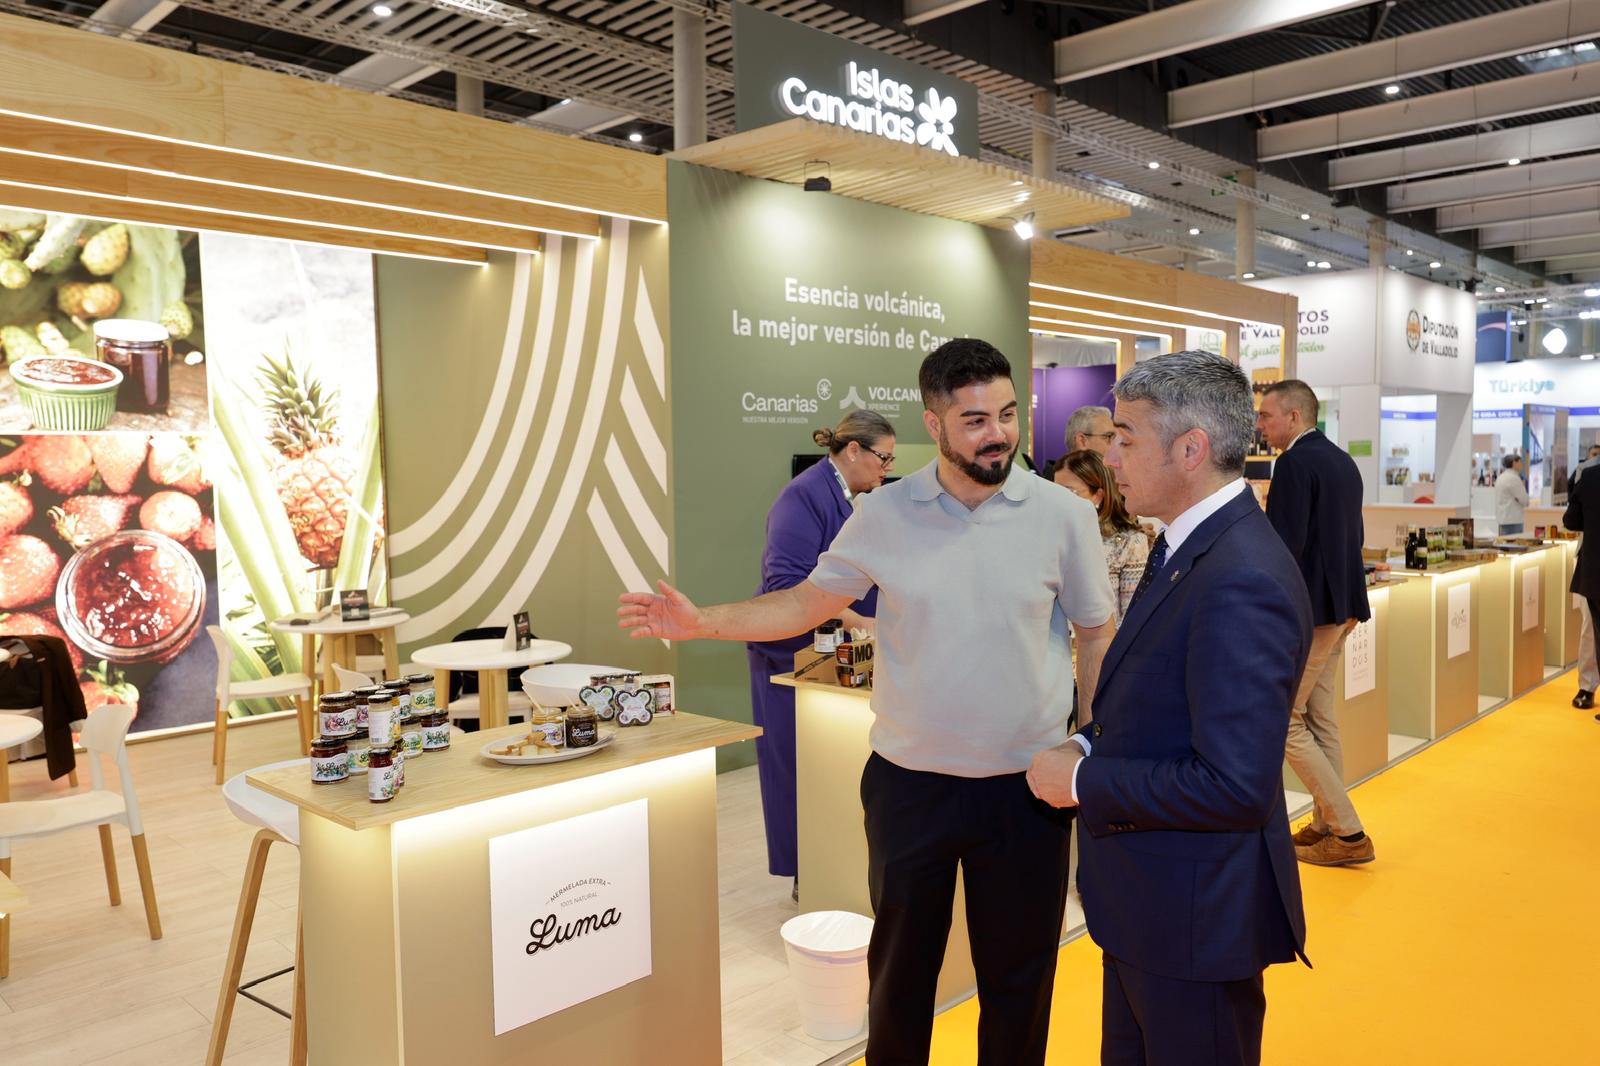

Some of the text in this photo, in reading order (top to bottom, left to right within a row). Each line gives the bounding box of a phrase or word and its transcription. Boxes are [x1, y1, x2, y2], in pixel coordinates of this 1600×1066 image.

[848, 61, 914, 112] Islas
[781, 77, 916, 144] Canarias
[784, 277, 945, 323] Esencia volcánica,
[732, 310, 752, 336] la
[759, 313, 818, 346] mejor
[823, 322, 890, 348] versión
[895, 328, 915, 350] de
[742, 392, 819, 413] Canarias
[868, 386, 922, 402] VOLCANI
[550, 878, 606, 902] MERMELADA EXTRA
[525, 907, 622, 955] Luma
